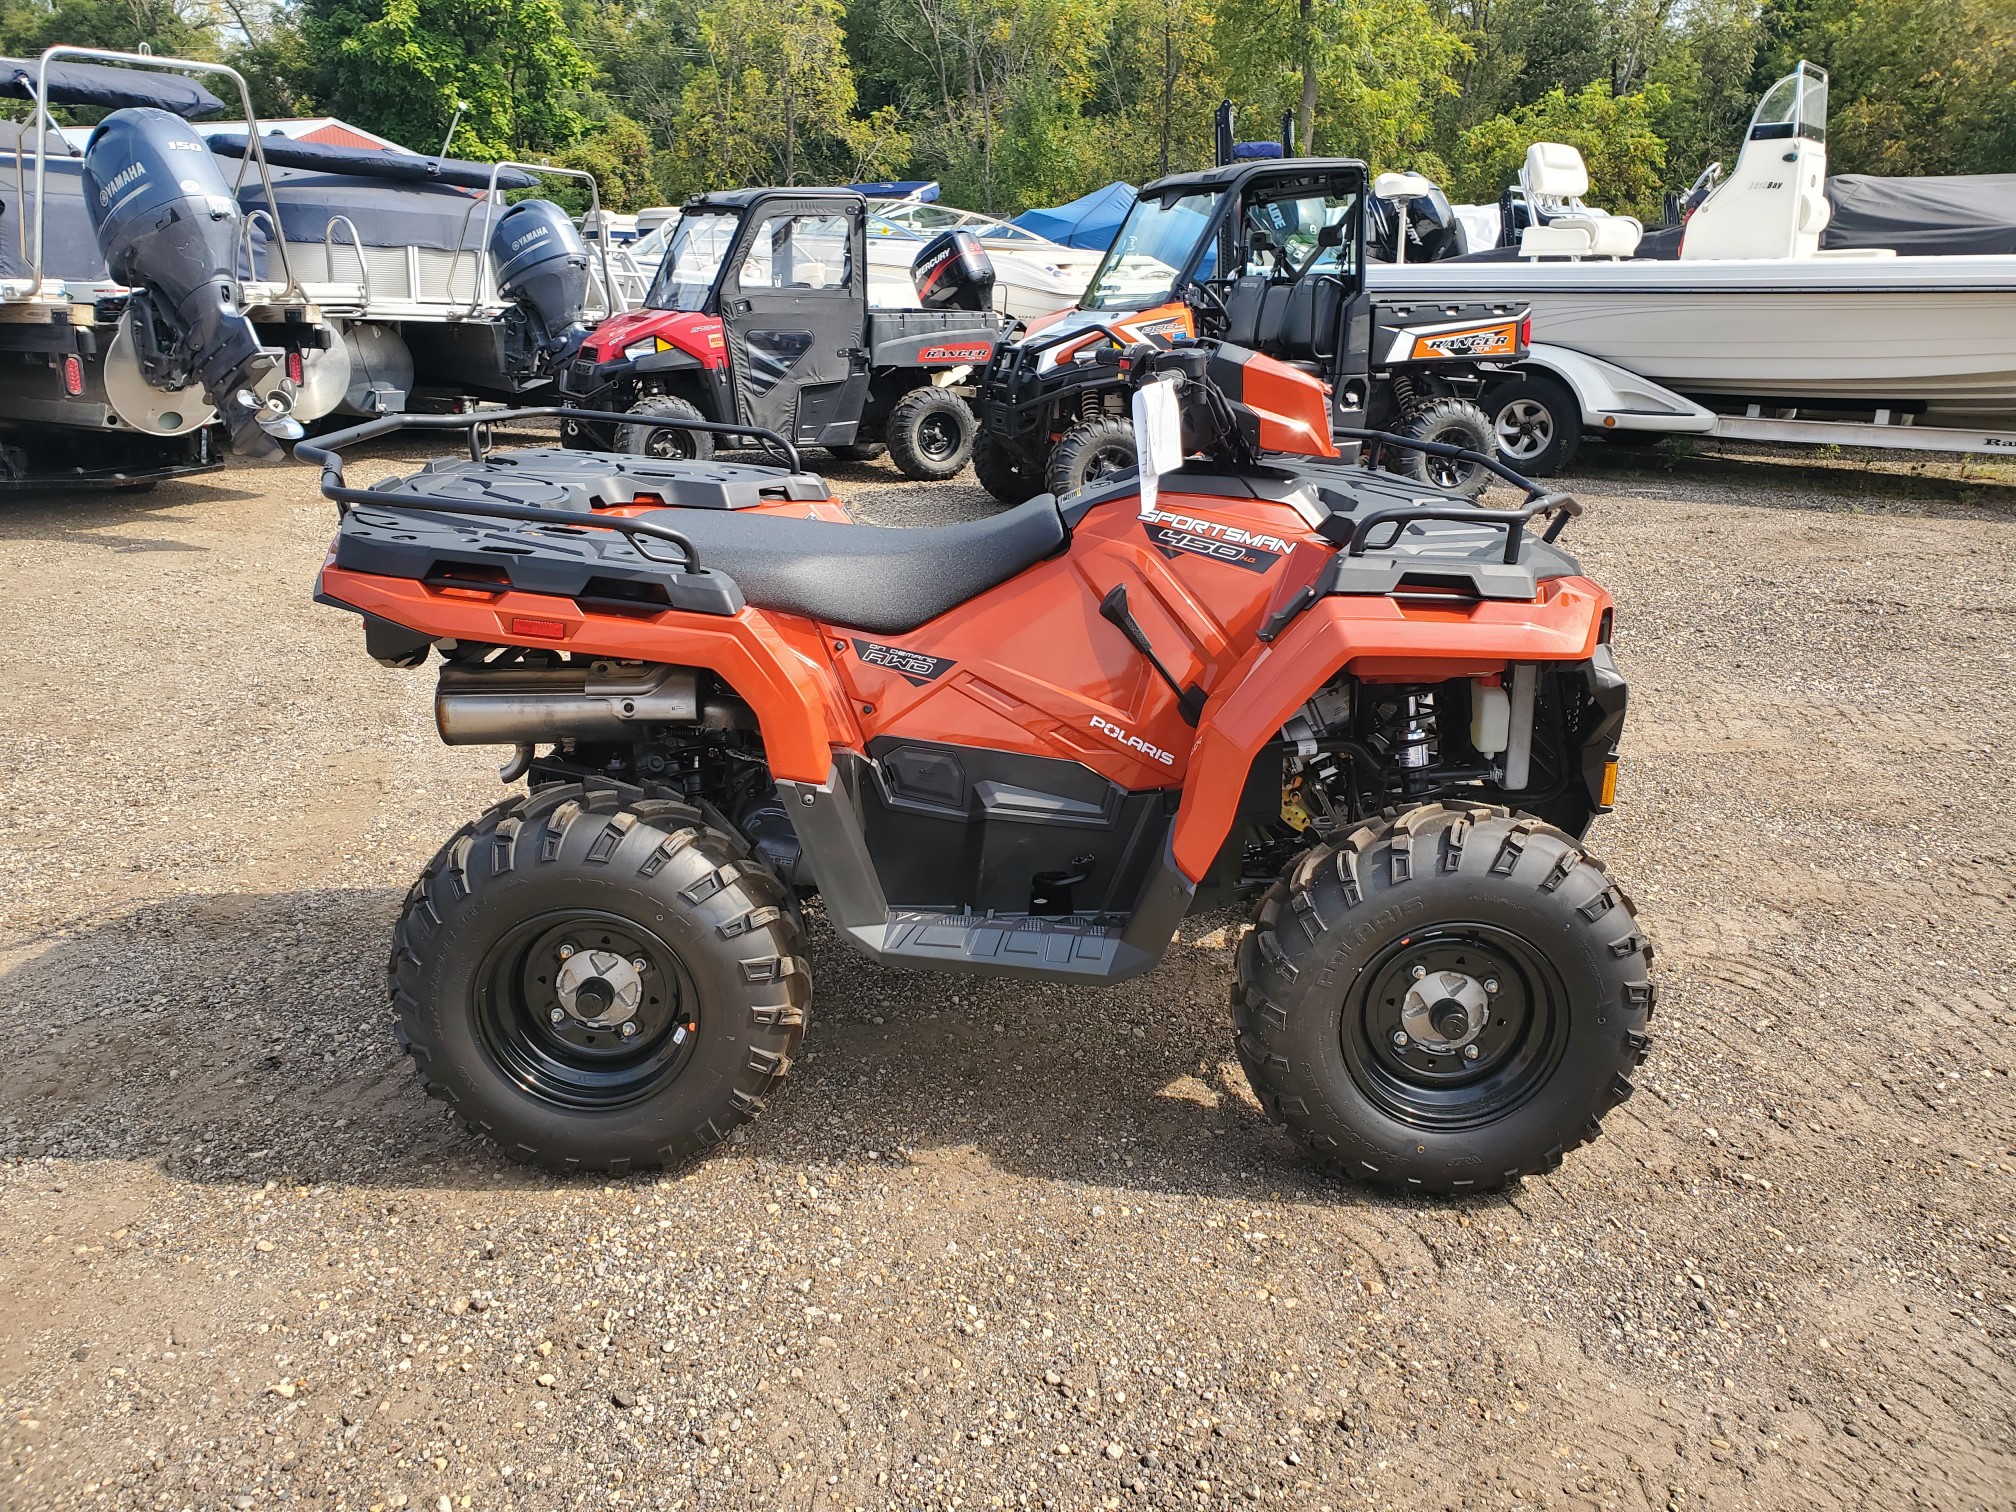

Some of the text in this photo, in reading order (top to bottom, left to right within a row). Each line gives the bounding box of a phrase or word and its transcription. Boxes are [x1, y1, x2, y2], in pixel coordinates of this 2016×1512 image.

[168, 141, 203, 152] 150
[106, 161, 147, 198] YAMAHA
[518, 226, 549, 247] YAMAHA
[970, 243, 980, 252] 90
[914, 248, 951, 283] MERCURY
[924, 349, 988, 359] RANGER
[1427, 336, 1509, 349] RANGER
[1136, 509, 1299, 555] SPORTSMAN
[1158, 529, 1246, 561] 450
[862, 649, 934, 675] AWD
[889, 648, 938, 664] DEMAND
[1089, 715, 1175, 766] POLARIS
